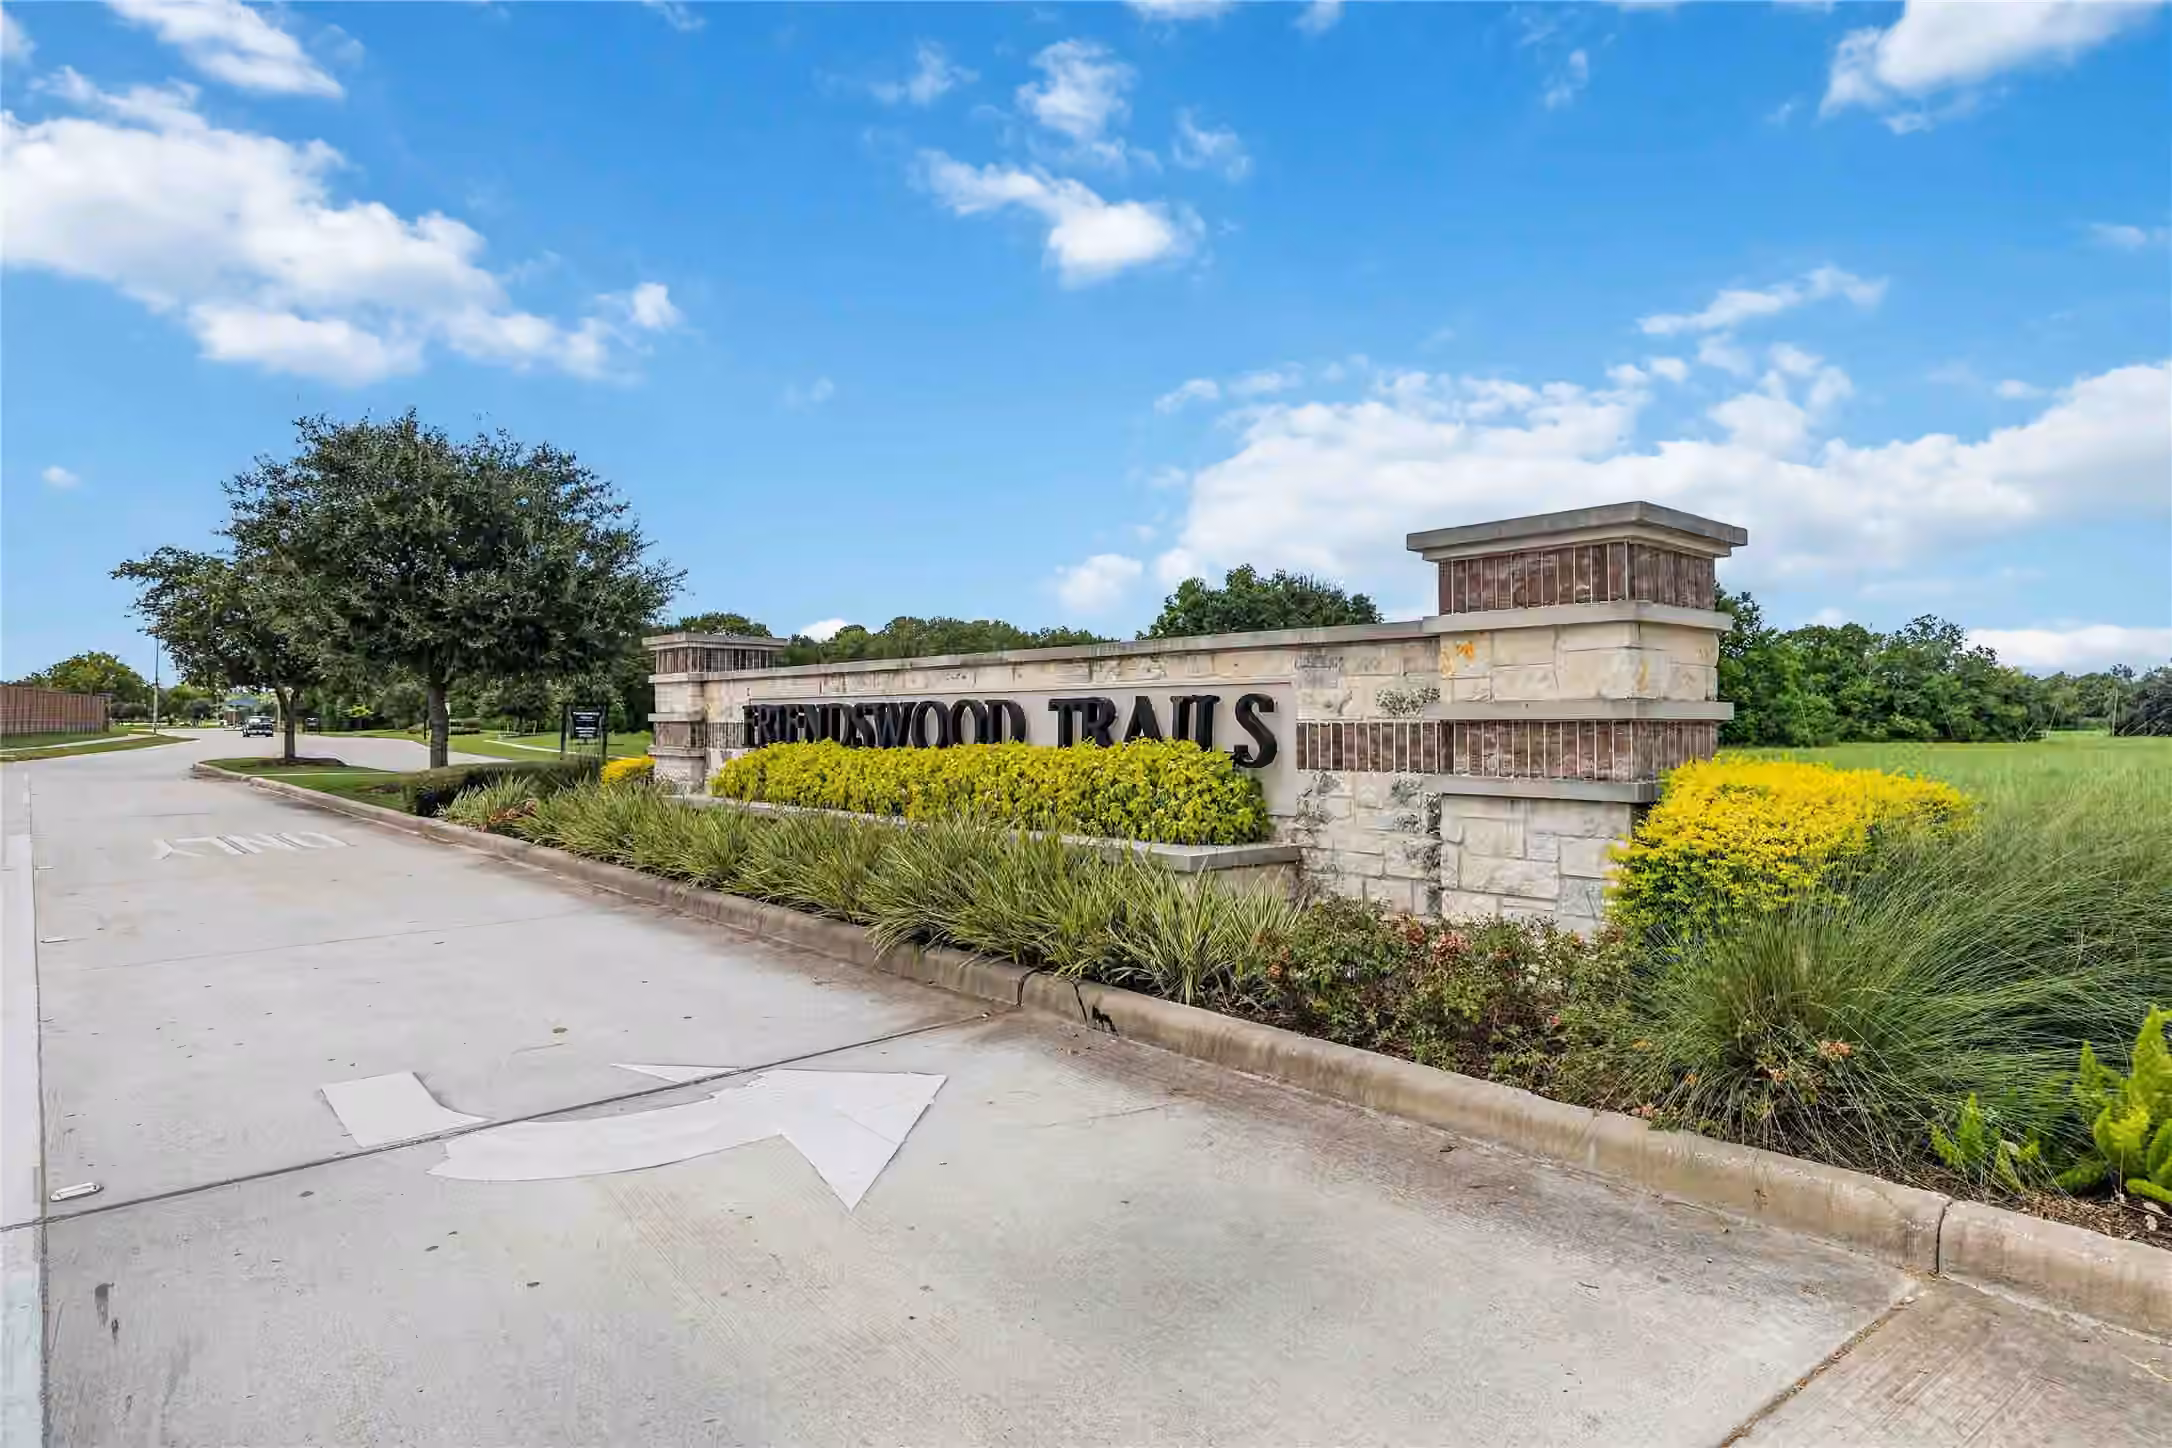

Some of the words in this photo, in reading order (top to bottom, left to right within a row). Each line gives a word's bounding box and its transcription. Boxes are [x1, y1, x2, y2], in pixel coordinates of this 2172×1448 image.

[742, 699, 1027, 749] FRIENDSWOOD
[1047, 693, 1278, 769] TRAILS
[151, 831, 352, 860] ONLY
